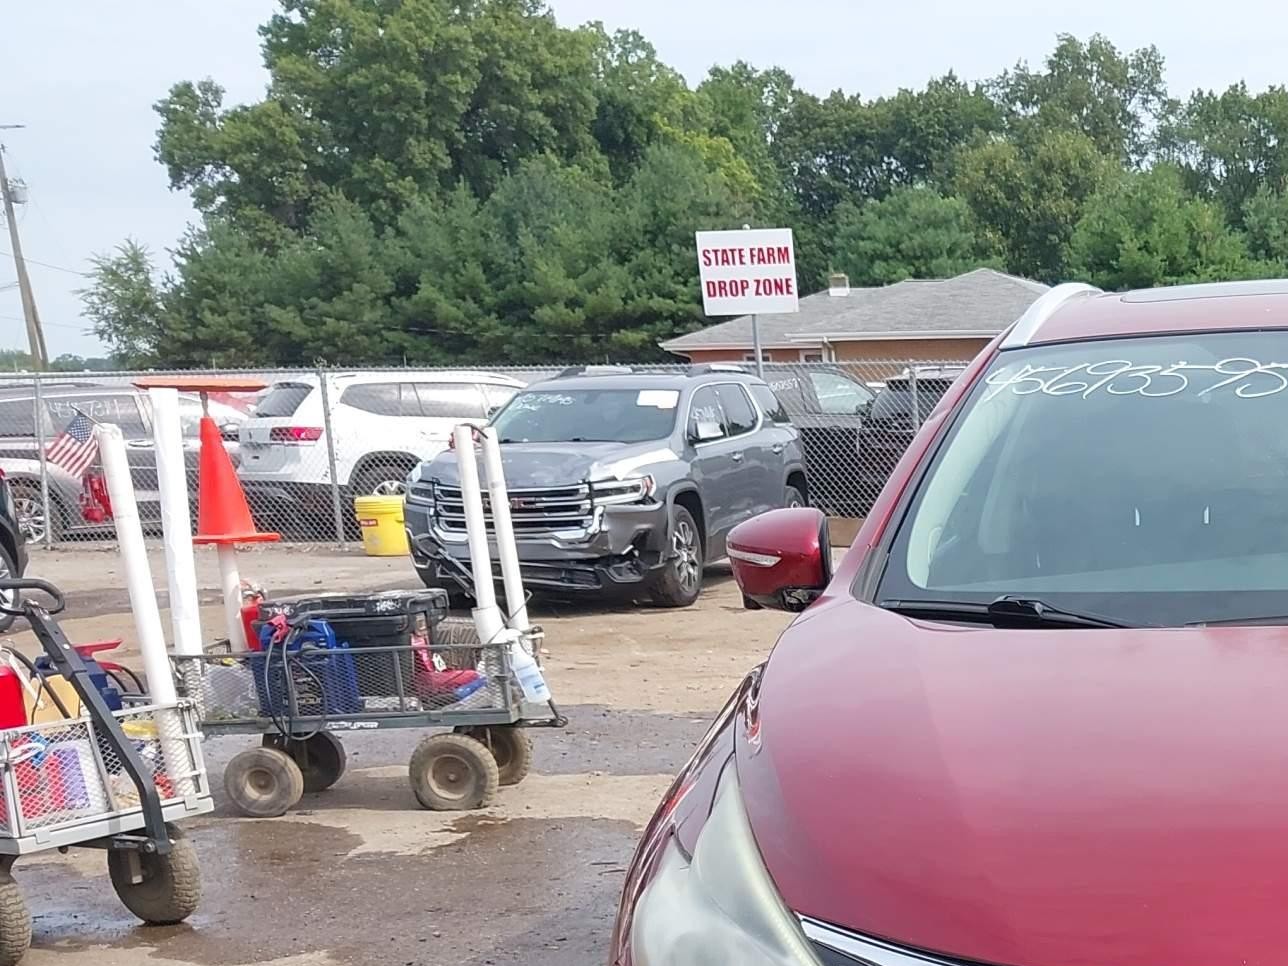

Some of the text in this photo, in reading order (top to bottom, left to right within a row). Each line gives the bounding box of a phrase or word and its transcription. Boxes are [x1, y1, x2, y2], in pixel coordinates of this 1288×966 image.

[702, 246, 791, 267] STATE FARM
[706, 278, 794, 298] DROP ZONE
